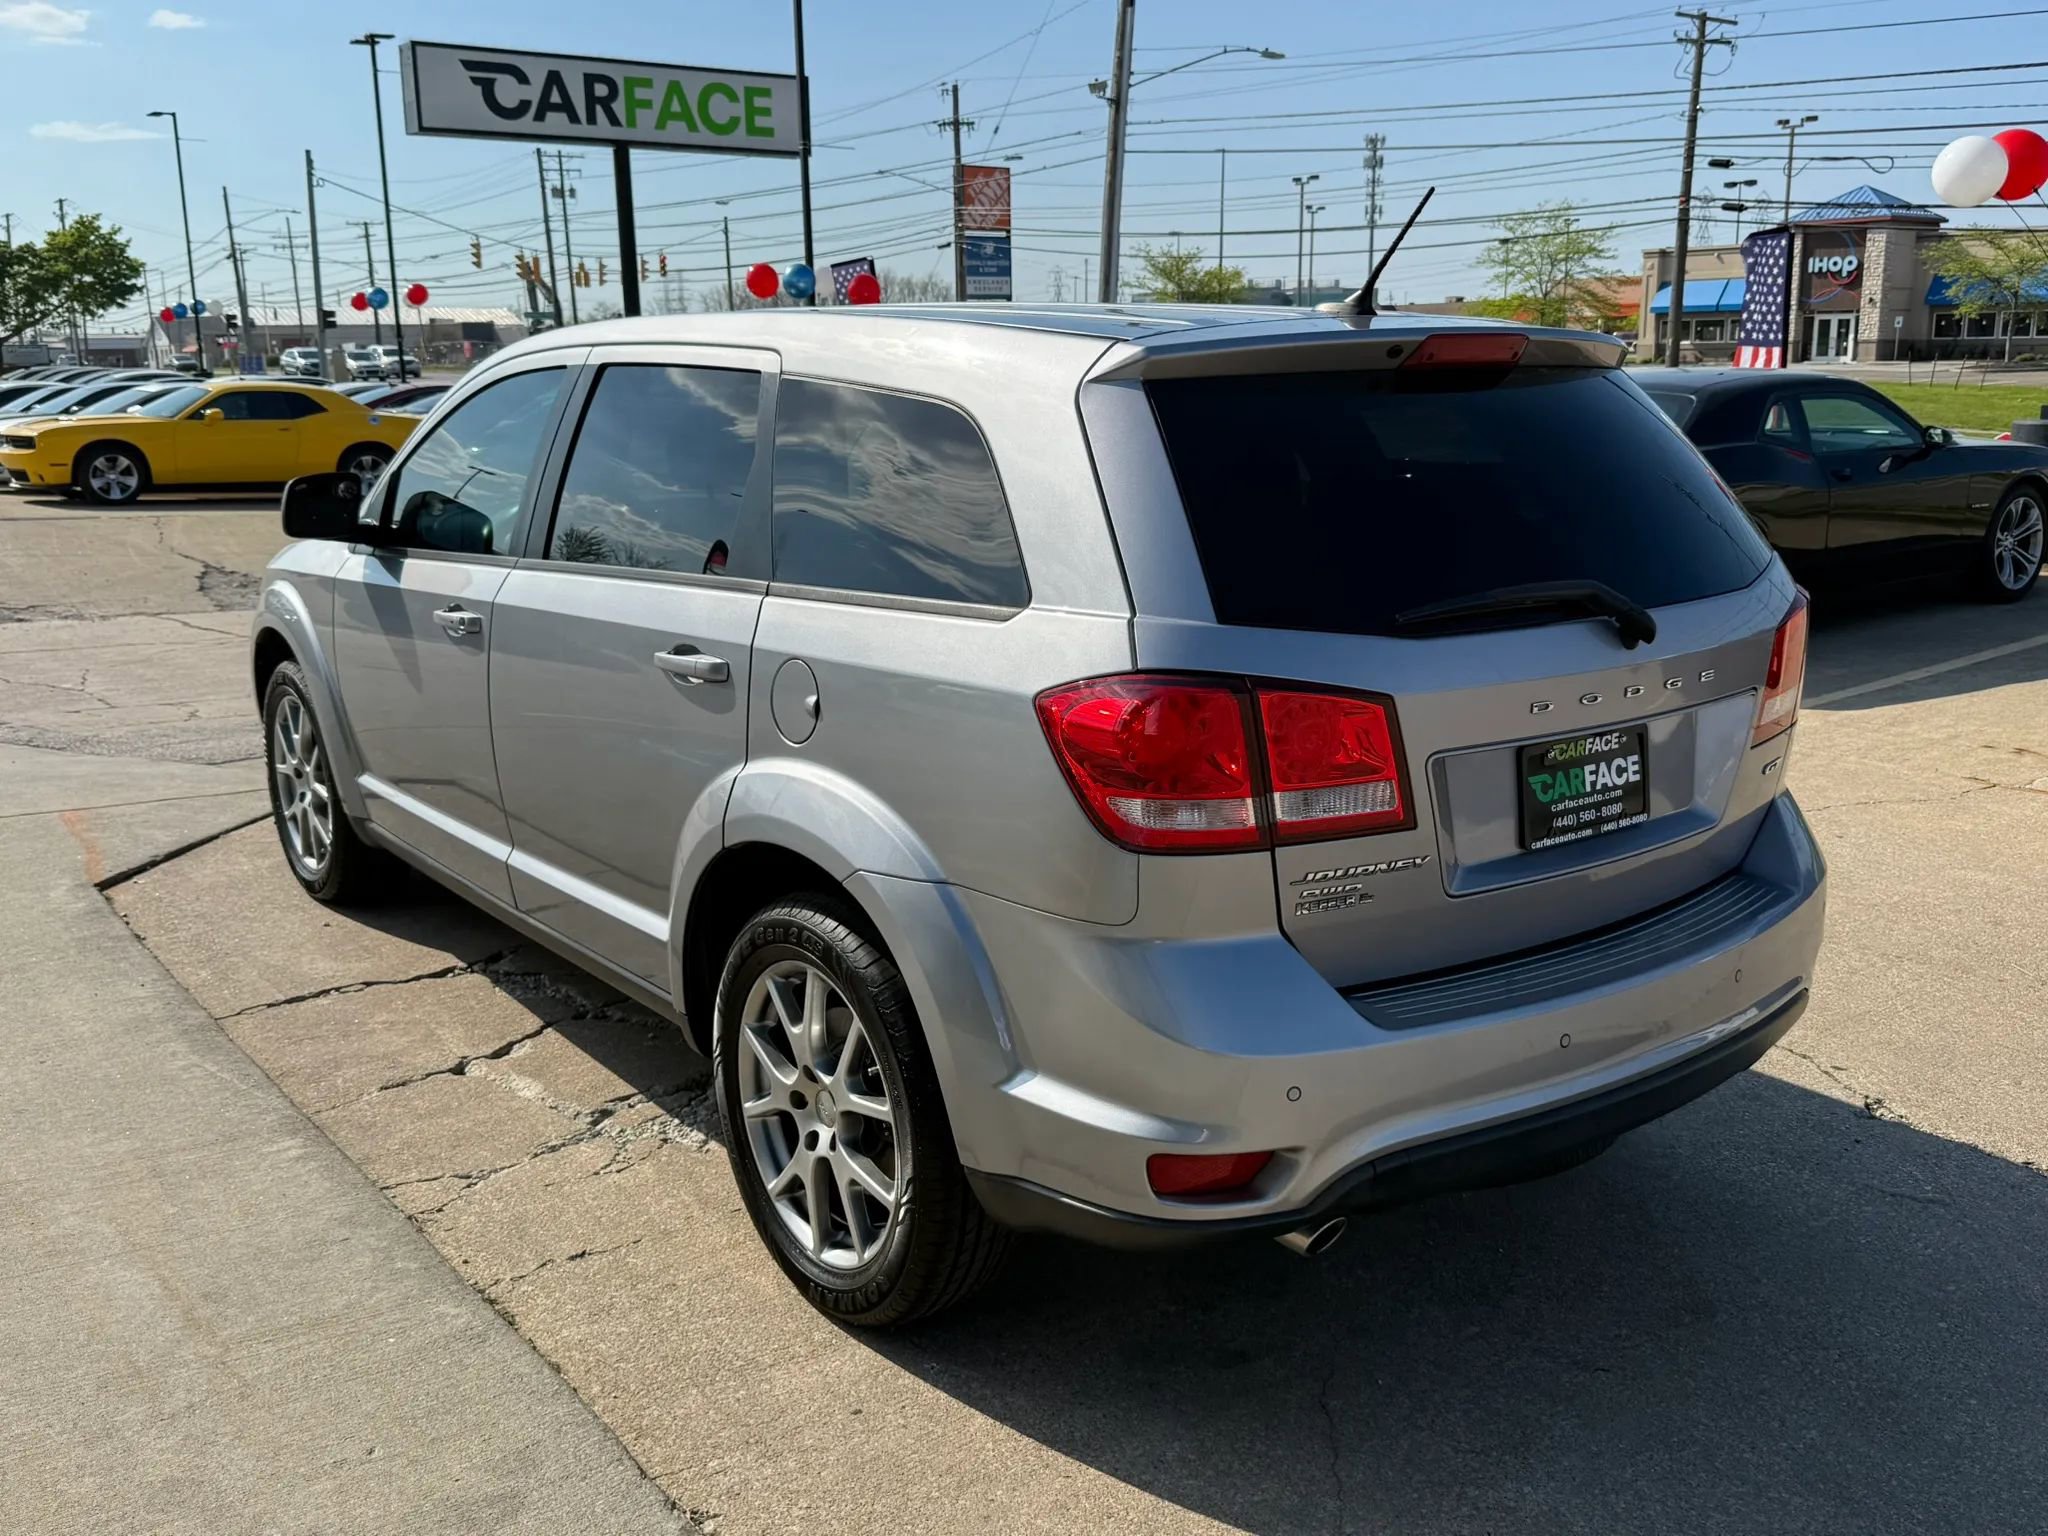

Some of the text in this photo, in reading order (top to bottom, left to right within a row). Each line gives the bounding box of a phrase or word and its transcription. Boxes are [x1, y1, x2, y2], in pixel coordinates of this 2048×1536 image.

[458, 59, 775, 138] CARFACE
[1808, 255, 1858, 277] IHOP
[1531, 670, 1715, 714] DODGE
[1554, 732, 1620, 760] CARFACE
[1528, 755, 1640, 803] CARFACE
[1551, 789, 1622, 812] carfaceauto.com
[1531, 813, 1648, 849] carfaceauto.com (440) 560-8080
[1553, 813, 1577, 828] (440)
[1290, 855, 1431, 885] JOURNEY
[1300, 883, 1362, 899] AWD
